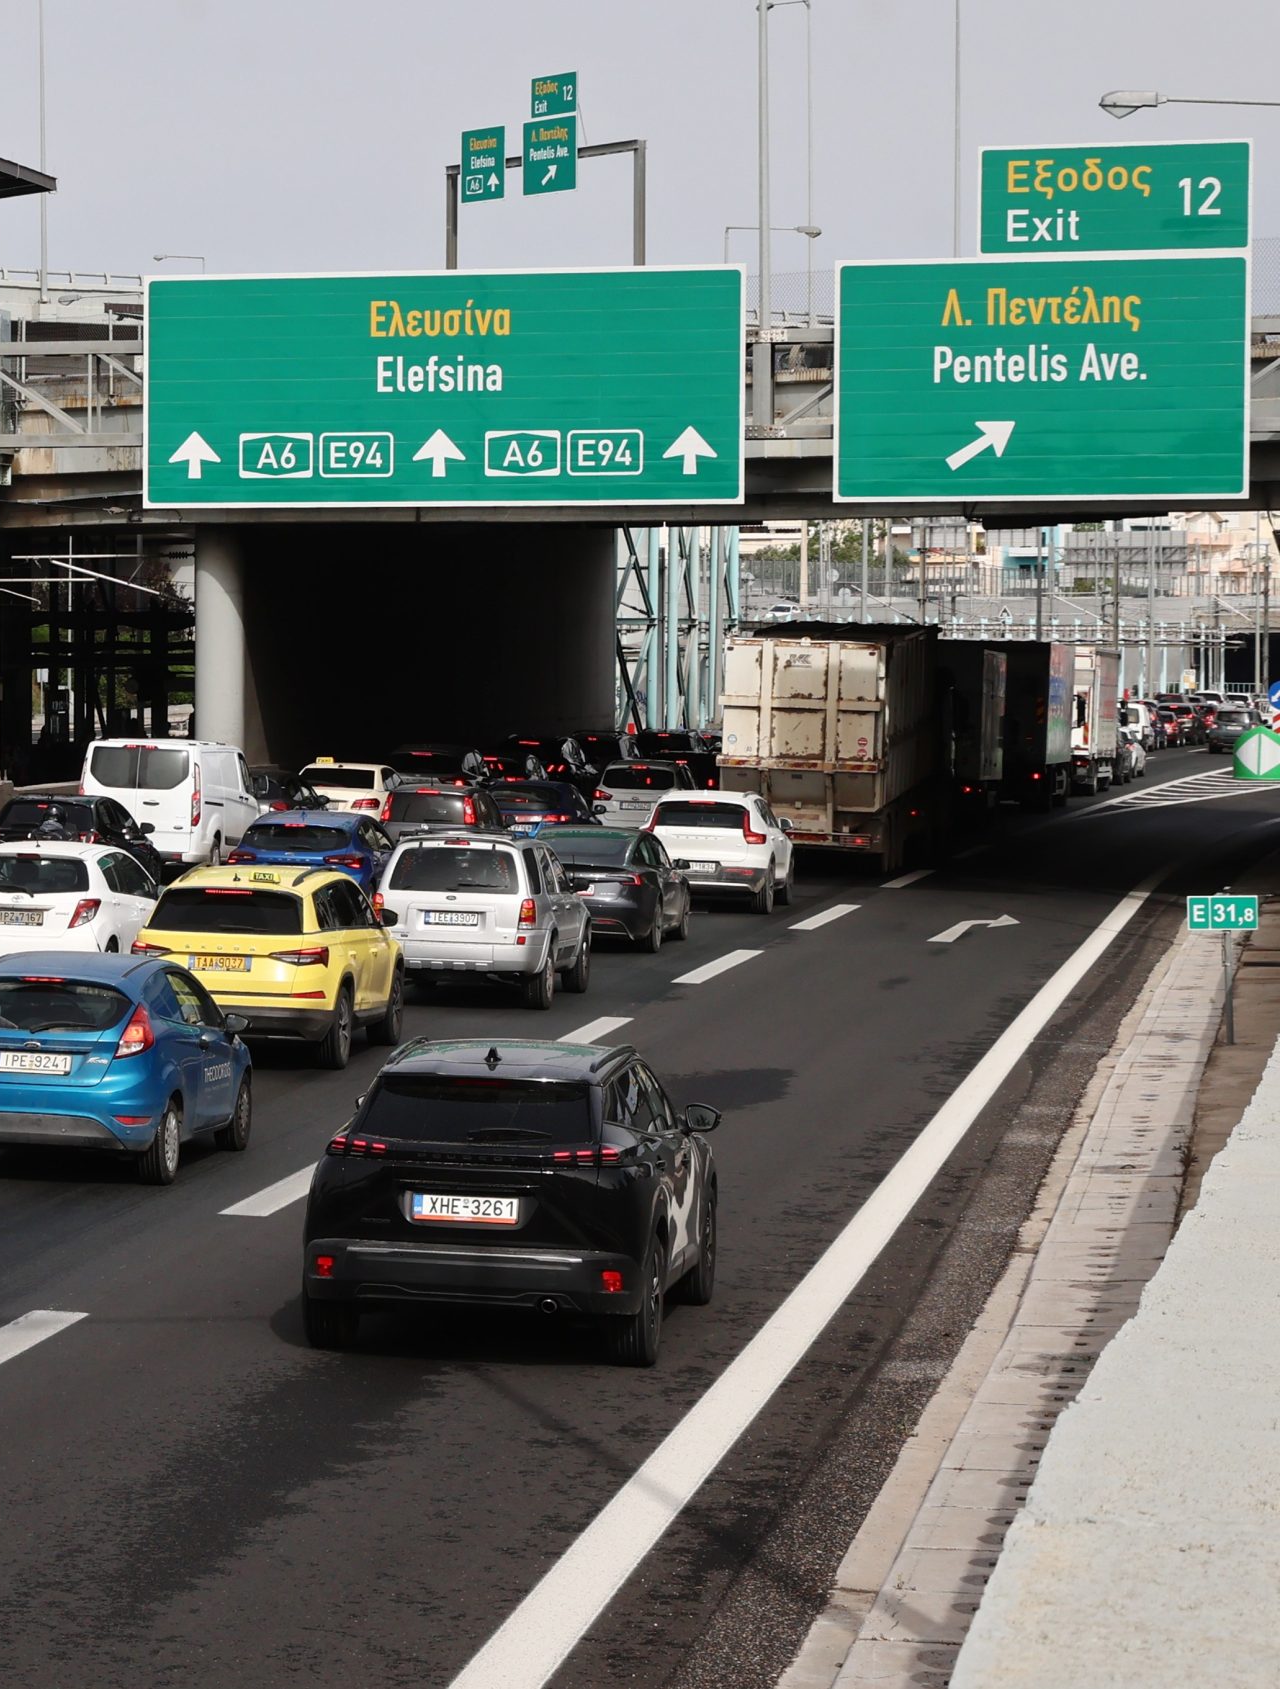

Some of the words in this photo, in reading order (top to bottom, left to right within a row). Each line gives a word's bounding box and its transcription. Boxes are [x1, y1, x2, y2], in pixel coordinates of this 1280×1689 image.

[563, 85, 573, 101] 12
[534, 100, 548, 114] Exit
[470, 155, 495, 169] Elefsina
[529, 146, 555, 161] Pentelis
[556, 144, 569, 158] Ave.
[469, 179, 480, 191] A6
[1007, 159, 1152, 199] Εξοδος
[1178, 176, 1222, 216] 12
[1006, 208, 1080, 242] Exit
[369, 299, 511, 338] Ελευσίνα
[940, 288, 973, 327] Λ.
[987, 286, 1141, 332] Πεντέλης
[376, 355, 503, 393] Elefsina
[933, 344, 1067, 384] Pentelis
[1079, 343, 1148, 381] Ave.
[257, 442, 297, 469] A6
[329, 441, 383, 469] E94
[503, 440, 543, 467] A6
[577, 439, 633, 467] E94
[254, 872, 274, 880] TAXI
[1193, 904, 1205, 922] E
[1213, 903, 1254, 926] 31,8
[429, 1196, 514, 1217] XHE-3261
